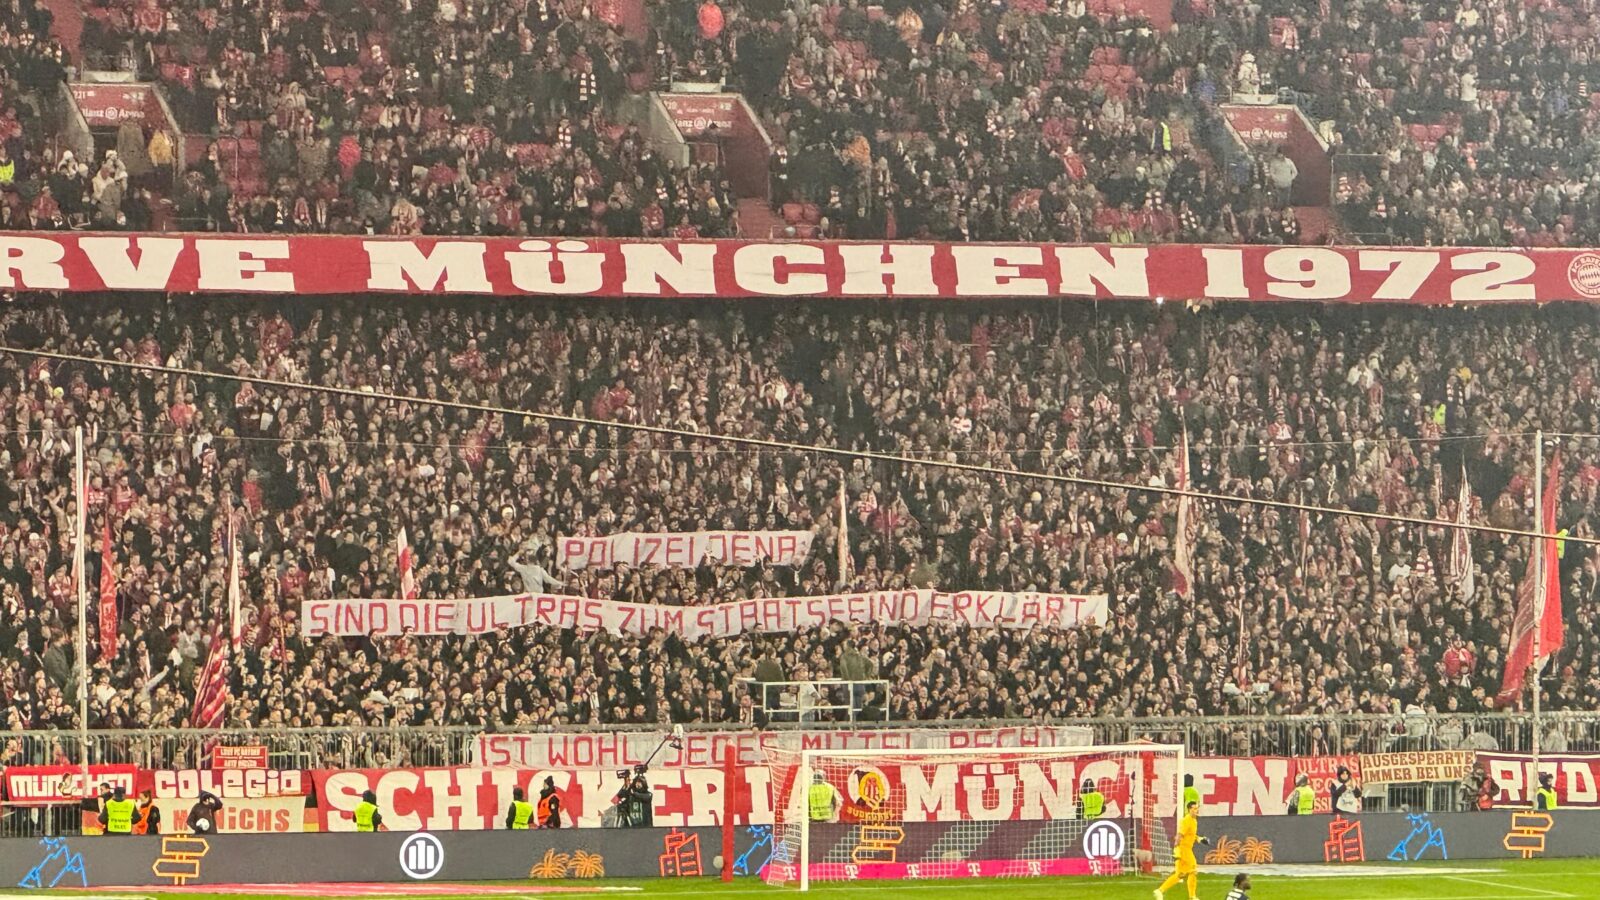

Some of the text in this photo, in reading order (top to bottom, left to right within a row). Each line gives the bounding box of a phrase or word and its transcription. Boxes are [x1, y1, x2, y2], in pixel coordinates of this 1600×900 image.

[363, 240, 1149, 297] MÜNCHEN
[1202, 247, 1536, 301] 1972
[565, 534, 796, 566] POLIZEI JENA
[310, 603, 388, 633] SIND
[399, 603, 455, 632] DIE
[466, 597, 602, 632] ULTRAS
[617, 606, 684, 635] ZUM
[930, 592, 1086, 625] ERKLÄRT
[480, 736, 531, 766] IST
[548, 735, 642, 766] WOHL
[1362, 751, 1474, 769] AUSGESPERRTE
[1363, 767, 1412, 783] IMMER
[1416, 766, 1440, 780] BEI
